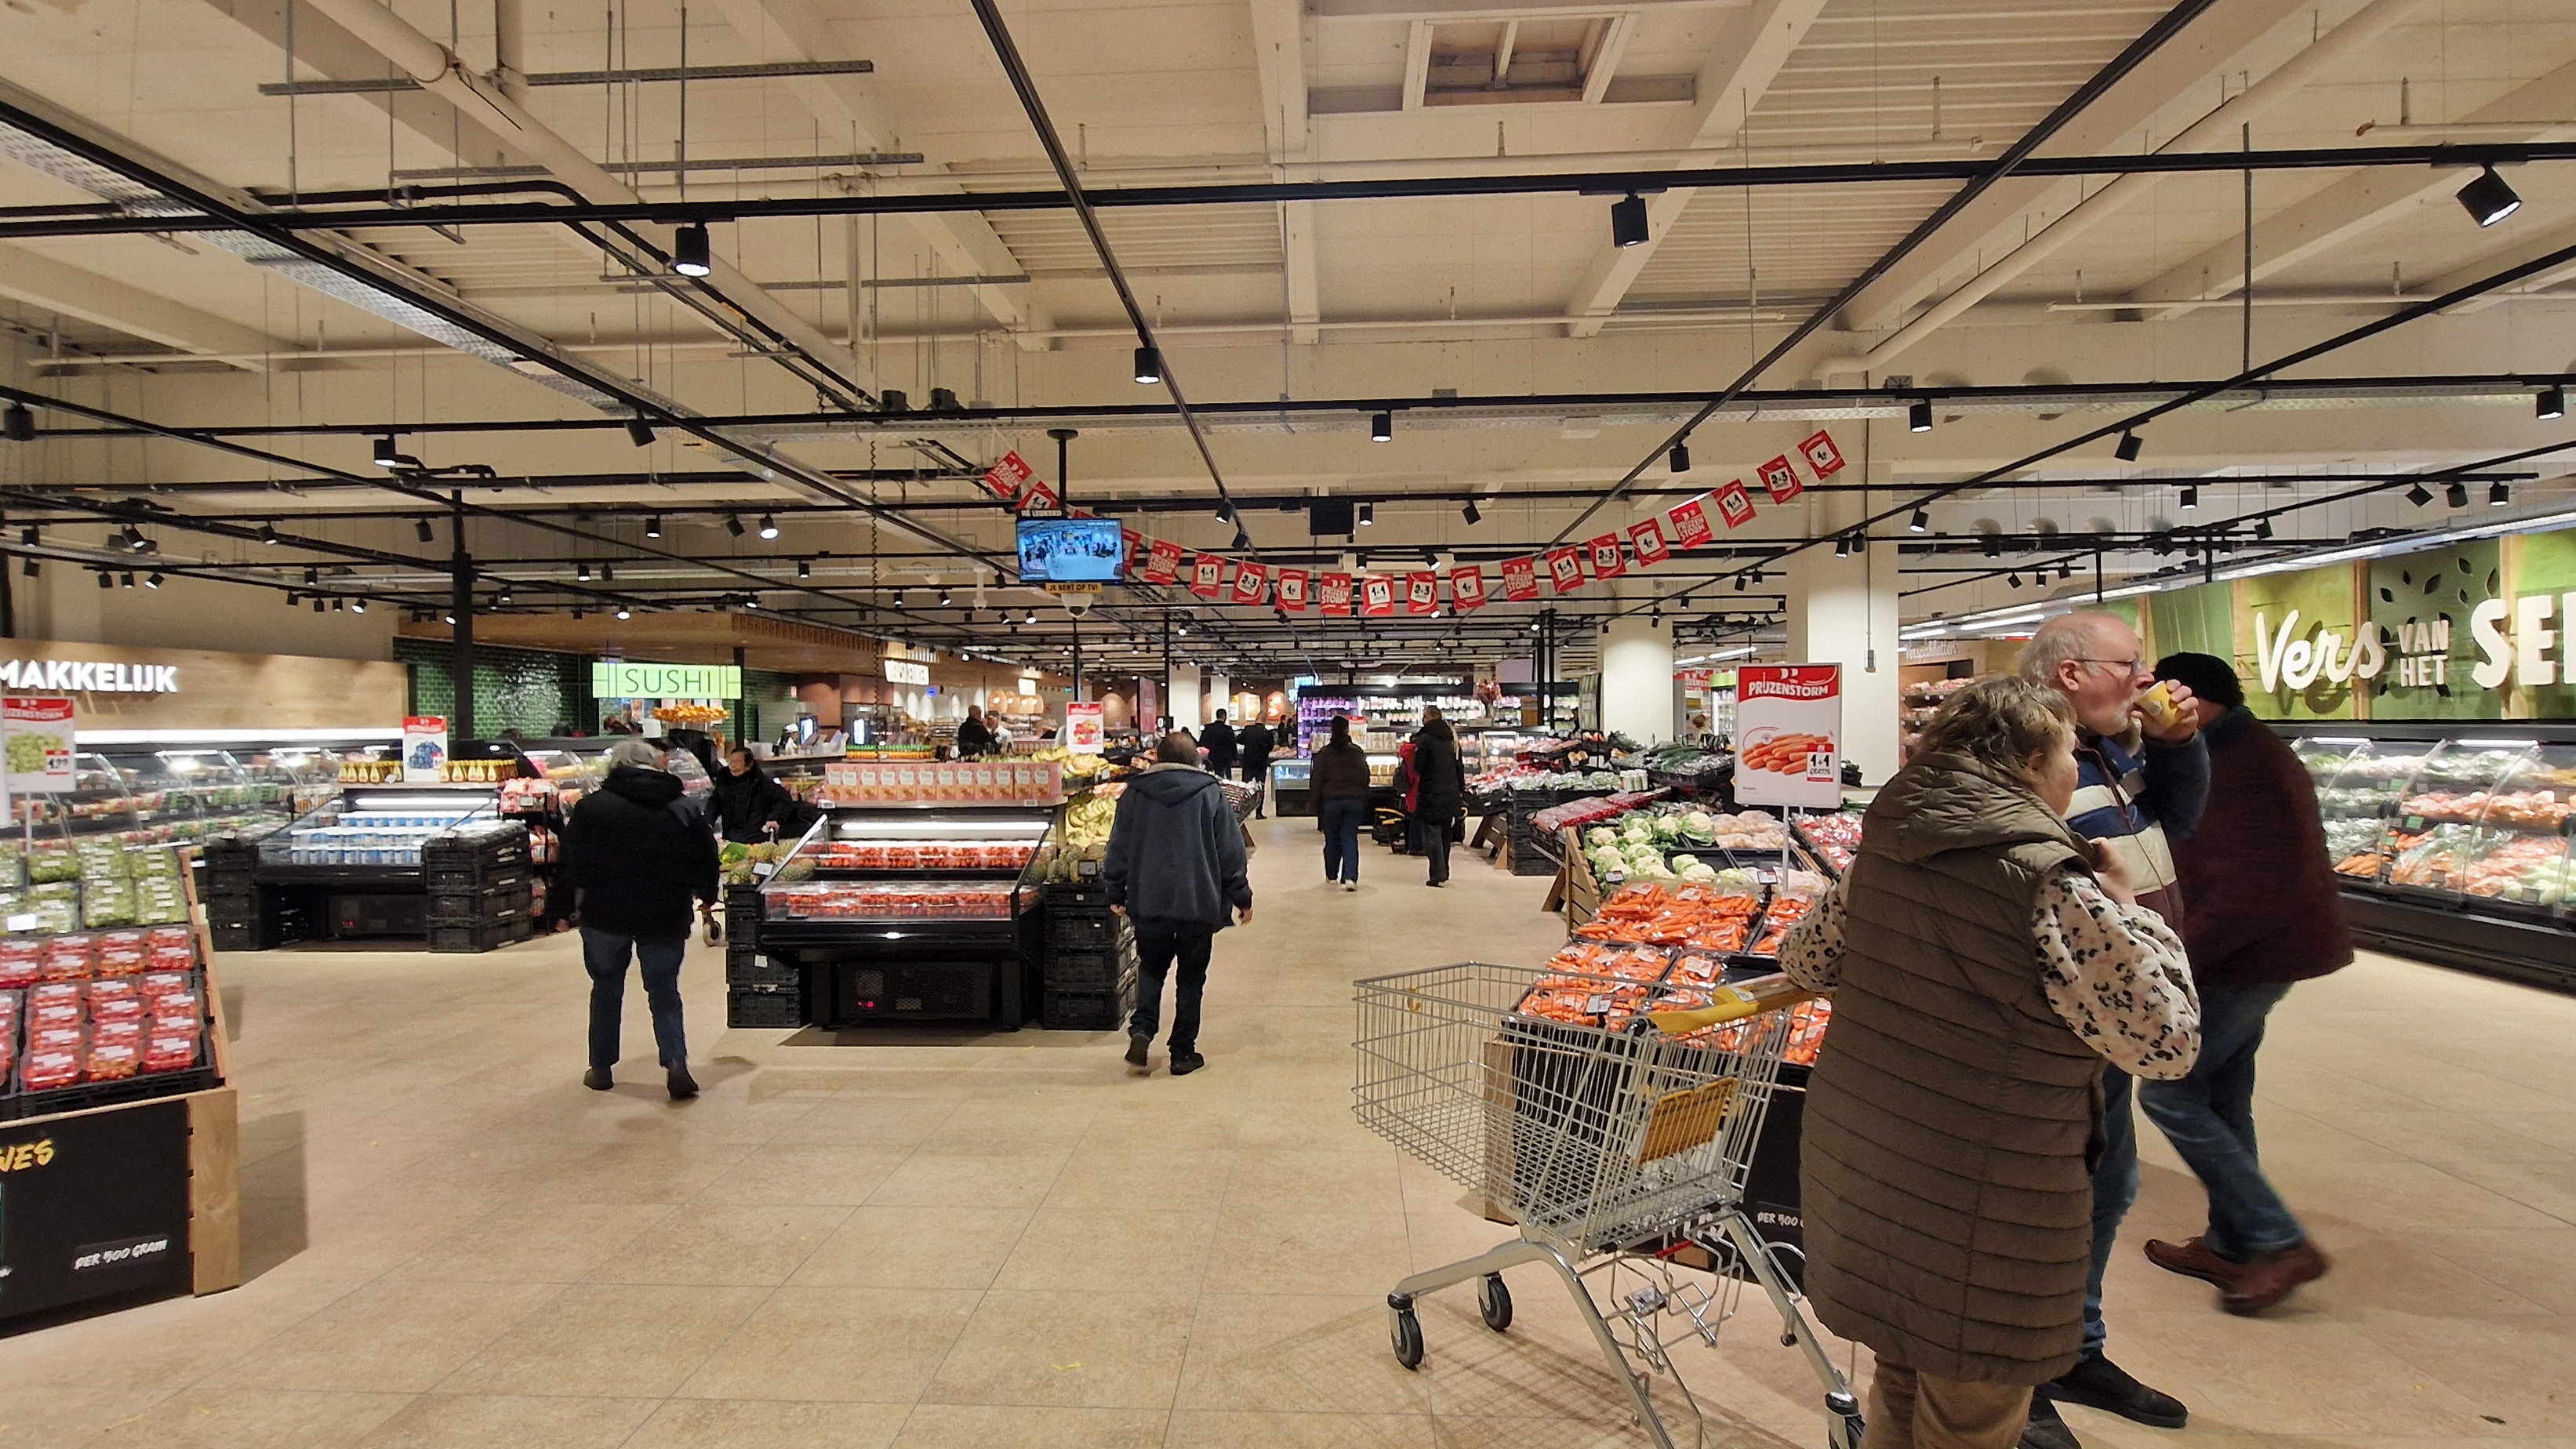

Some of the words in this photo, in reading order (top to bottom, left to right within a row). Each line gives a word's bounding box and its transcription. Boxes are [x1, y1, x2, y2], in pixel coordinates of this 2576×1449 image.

[2397, 619, 2449, 653] VAN
[2256, 609, 2386, 693] Vers
[625, 669, 710, 693] SUSHI
[2400, 655, 2449, 687] HET
[1748, 681, 1829, 697] PRIJZENSTORM
[1810, 754, 1829, 767] 1+1
[1757, 1211, 1775, 1224] PER
[1778, 1213, 1798, 1227] 500
[73, 1252, 101, 1271] PER
[102, 1247, 131, 1264] 500
[132, 1239, 168, 1258] GRAM
